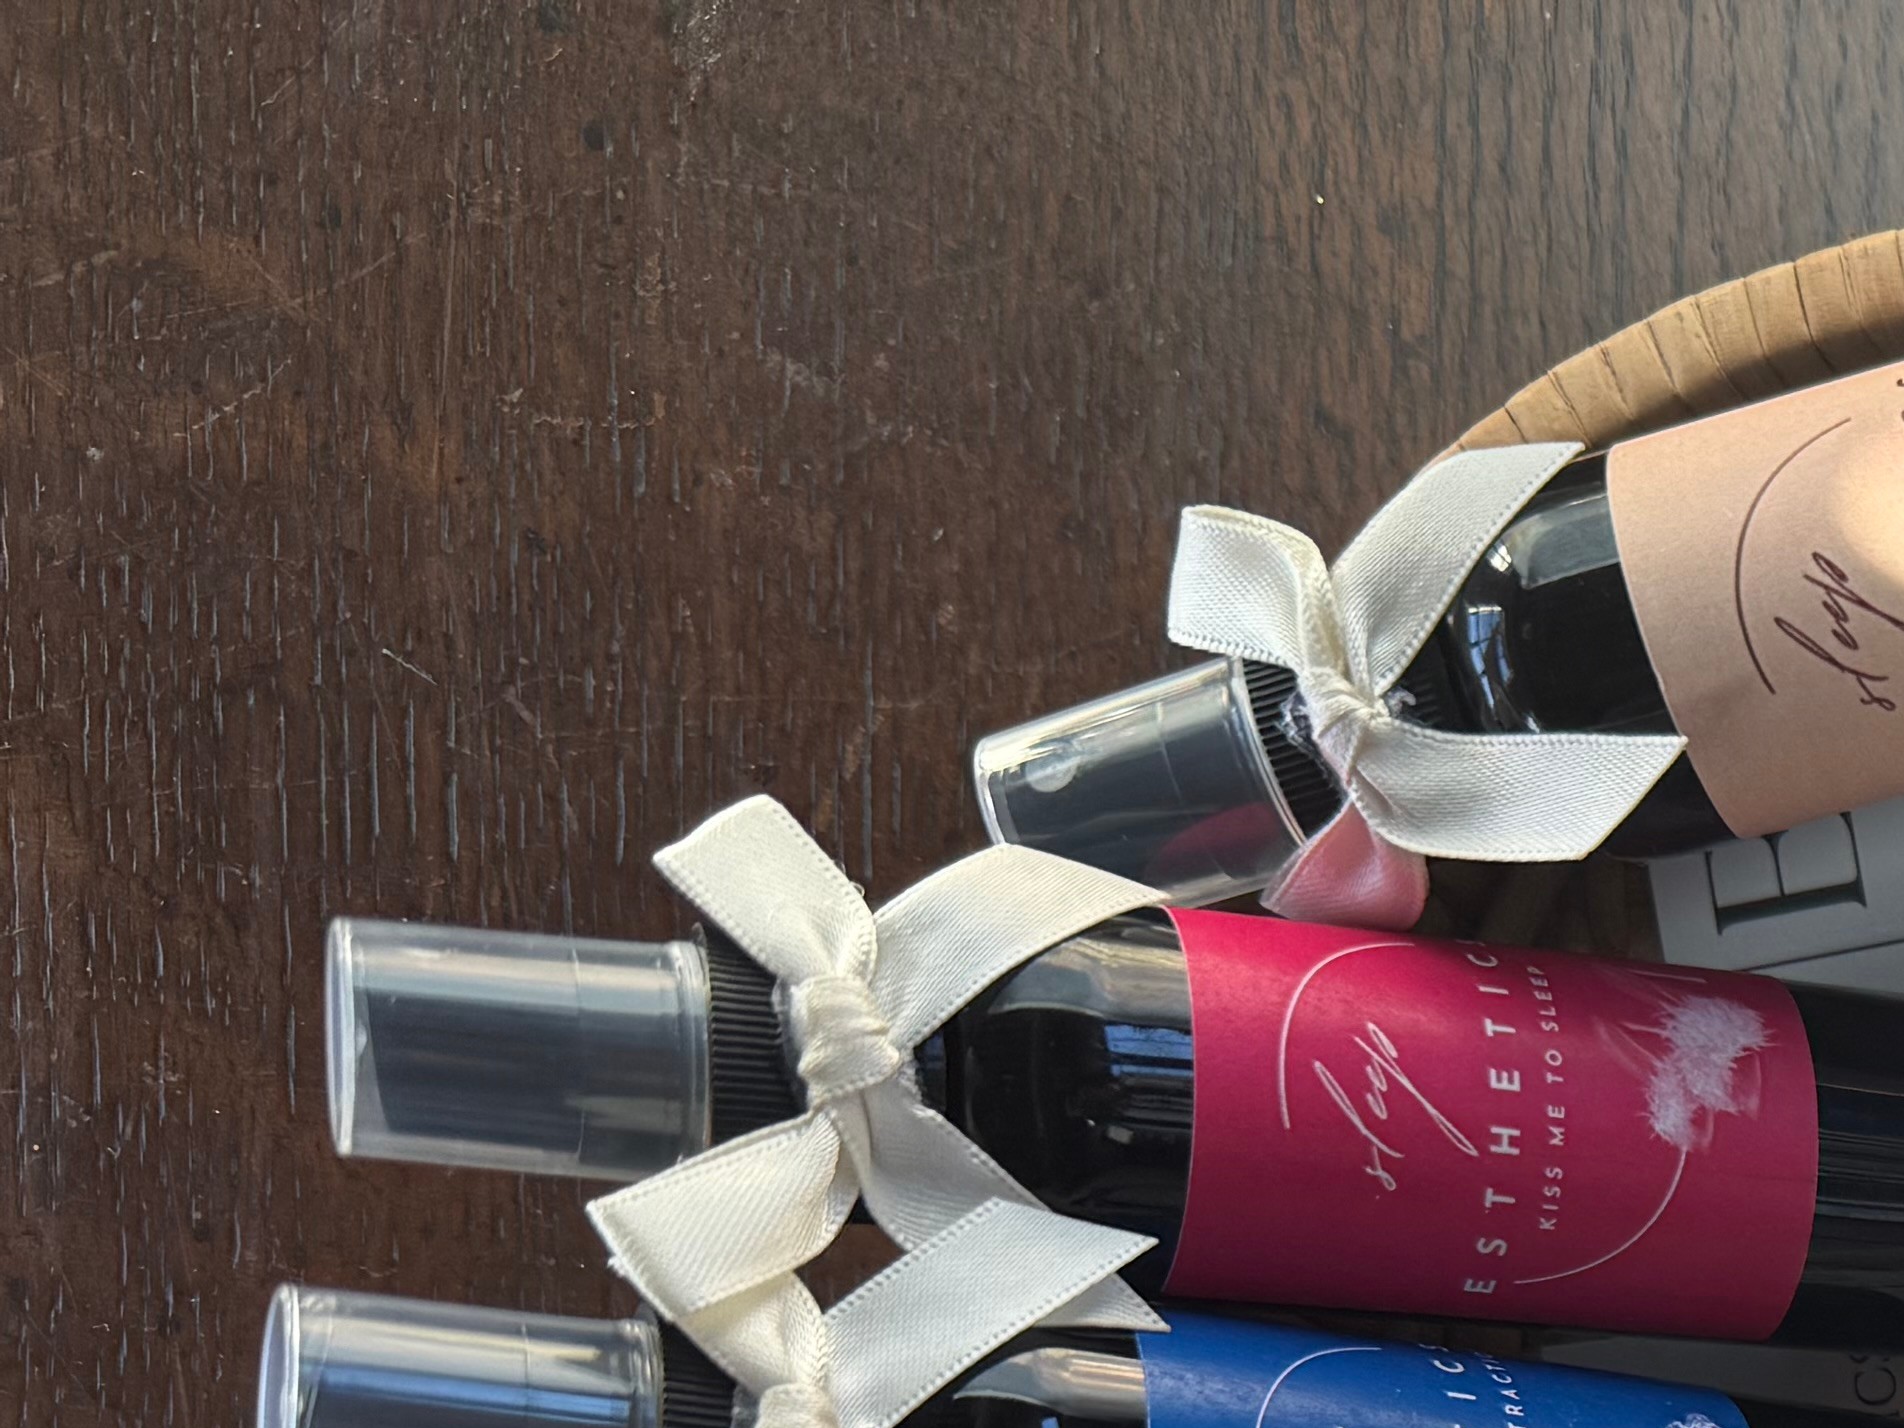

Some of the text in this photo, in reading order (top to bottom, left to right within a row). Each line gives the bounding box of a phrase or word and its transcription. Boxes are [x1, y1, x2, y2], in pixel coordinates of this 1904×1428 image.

[1314, 1020, 1479, 1191] sleep
[1454, 938, 1521, 1294] ESTHETIC
[1526, 966, 1567, 1230] KISS ME TO SLEEP
